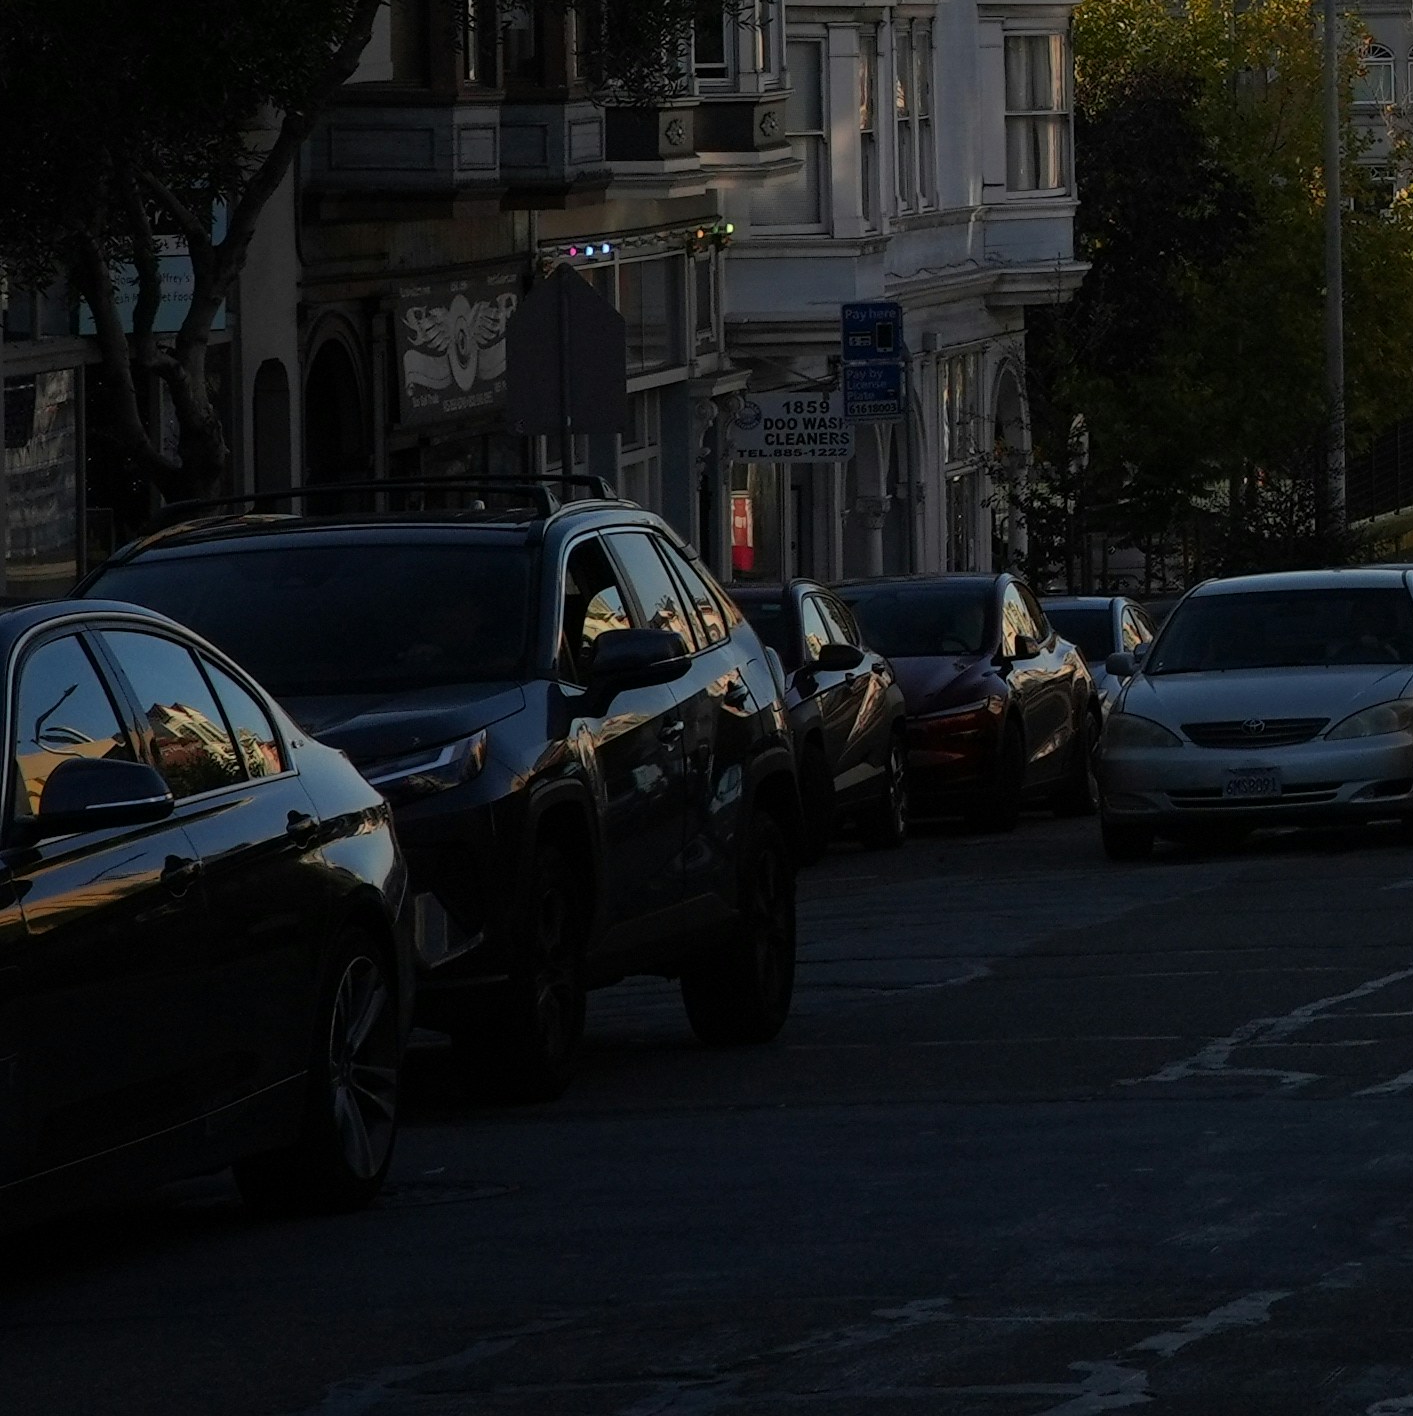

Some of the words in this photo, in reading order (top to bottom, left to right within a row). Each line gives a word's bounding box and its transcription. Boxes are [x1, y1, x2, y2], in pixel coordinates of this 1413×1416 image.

[845, 307, 867, 323] Pay
[868, 308, 897, 320] here
[868, 368, 884, 381] by
[782, 400, 830, 415] 1859
[764, 418, 798, 431] DOO
[765, 432, 850, 446] CLEANERS
